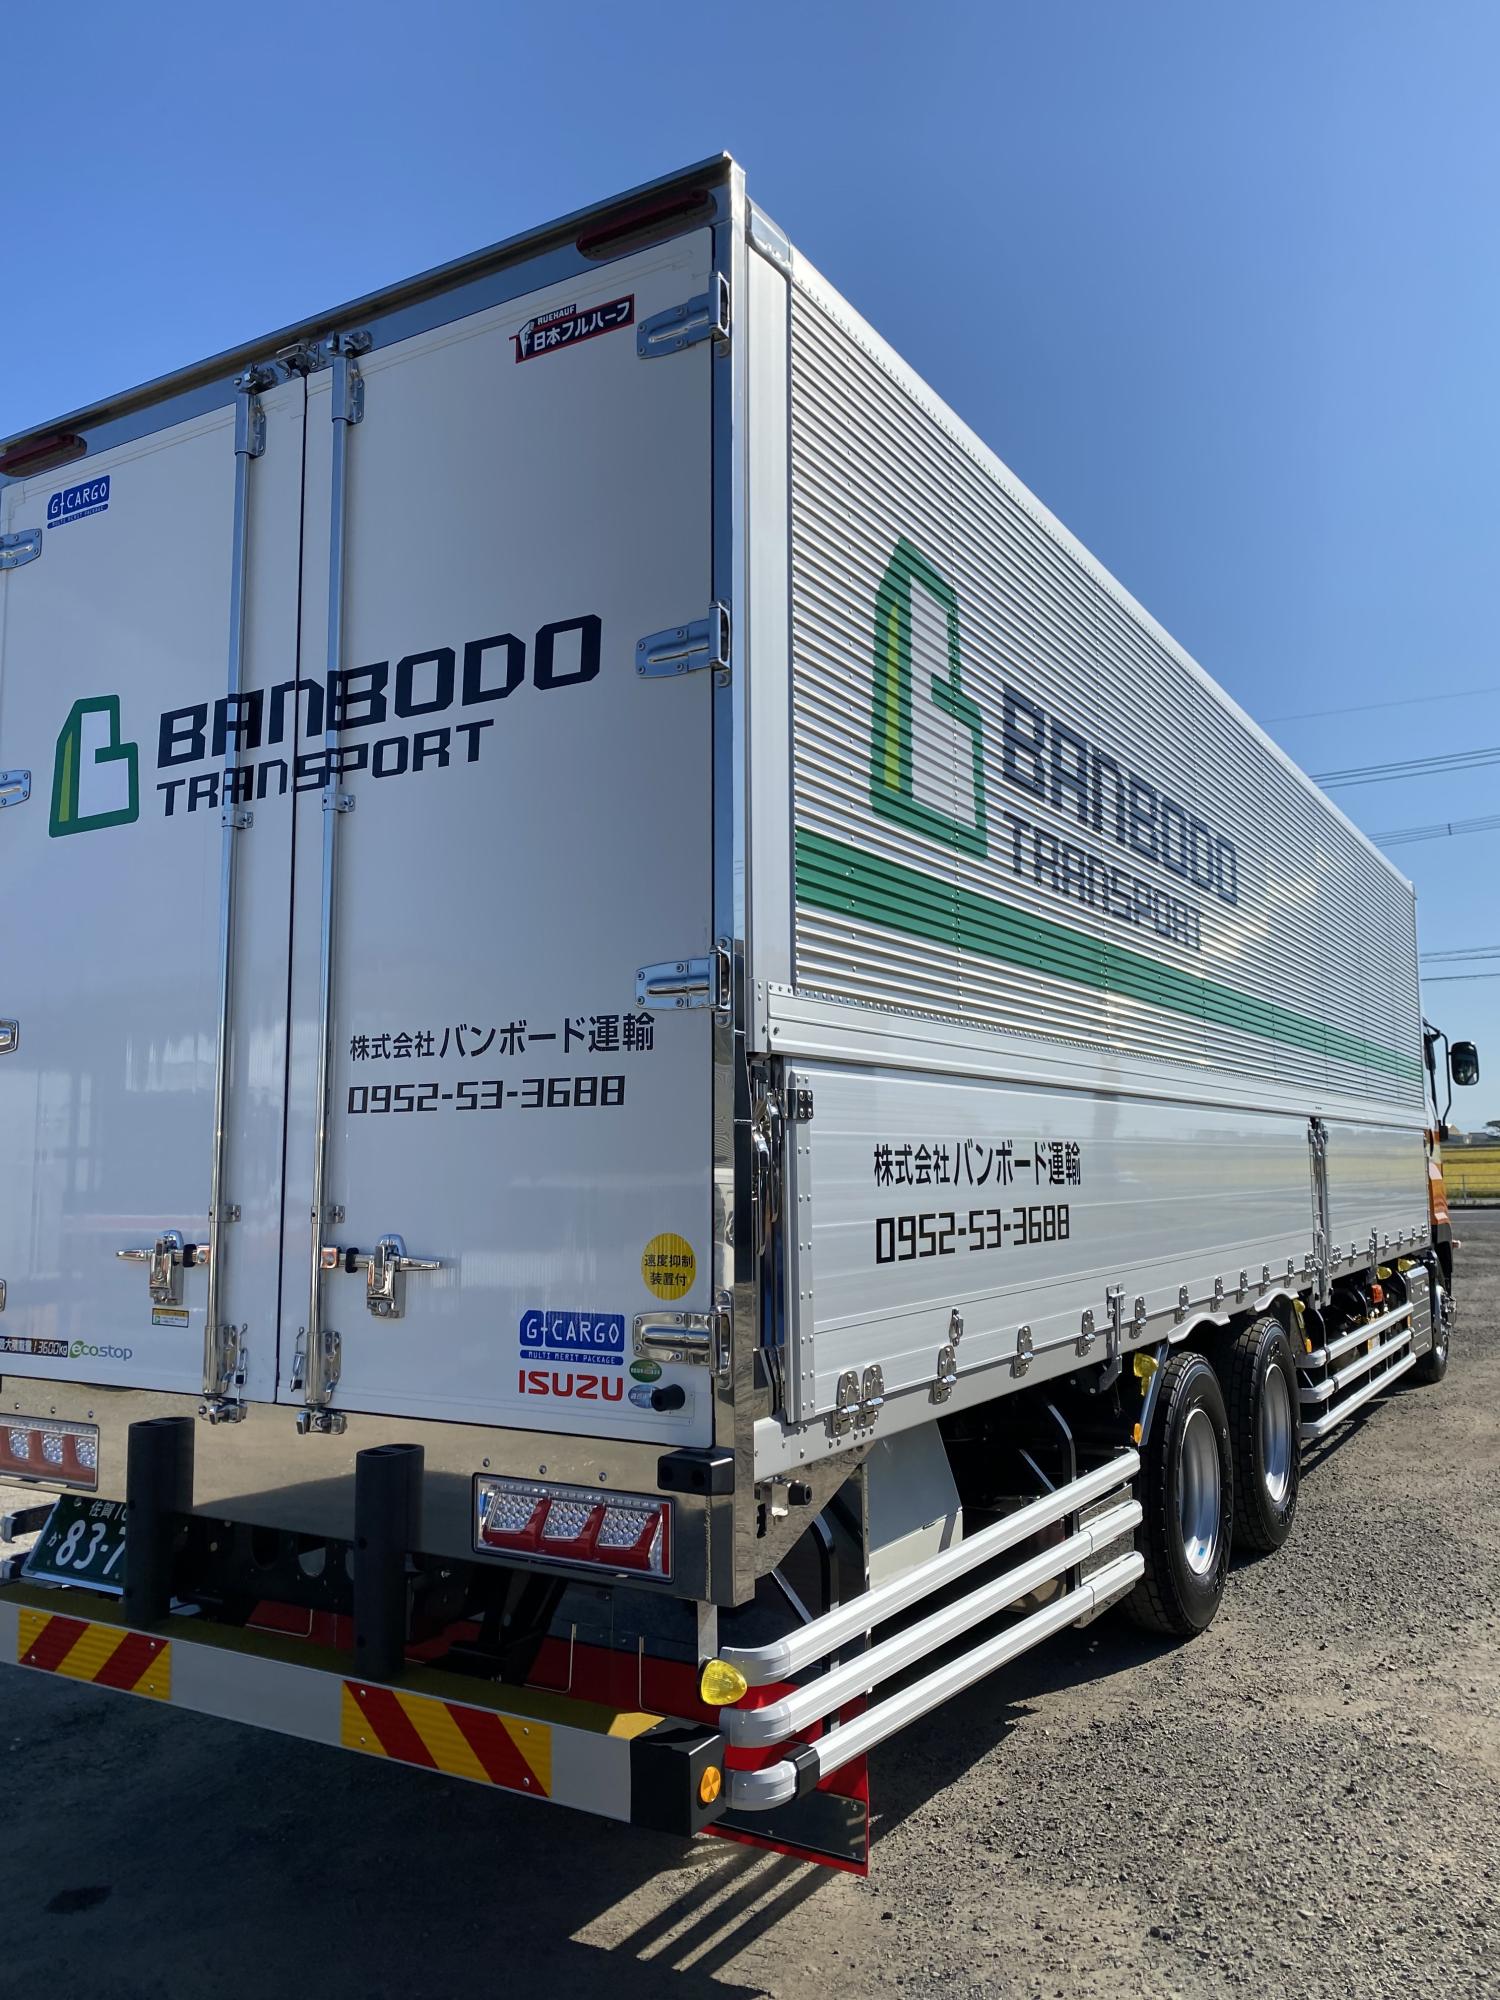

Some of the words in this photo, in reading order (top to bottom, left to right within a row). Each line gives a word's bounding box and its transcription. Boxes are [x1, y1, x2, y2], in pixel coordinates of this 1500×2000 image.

[533, 301, 630, 351] 日本フルハーフ
[157, 614, 601, 768] BANBODO
[157, 719, 494, 817] TRANSPORT
[1003, 682, 1238, 906] BANBODO
[1003, 810, 1202, 949] TRANSPORT
[350, 1012, 655, 1061] 株式会社バンボード運輸
[348, 1075, 625, 1114] 0952-53-3688
[874, 1138, 1081, 1186] 株式会社バンボード運輸
[876, 1204, 1070, 1264] 0952-53-3688
[644, 1254, 693, 1269] 速度抑制
[650, 1272, 687, 1287] 装置付
[71, 1342, 132, 1361] ecostop
[528, 1351, 550, 1359] MULTI
[554, 1353, 579, 1361] MERIT
[583, 1355, 615, 1364] PACKAGE
[518, 1370, 623, 1401] ISUZU
